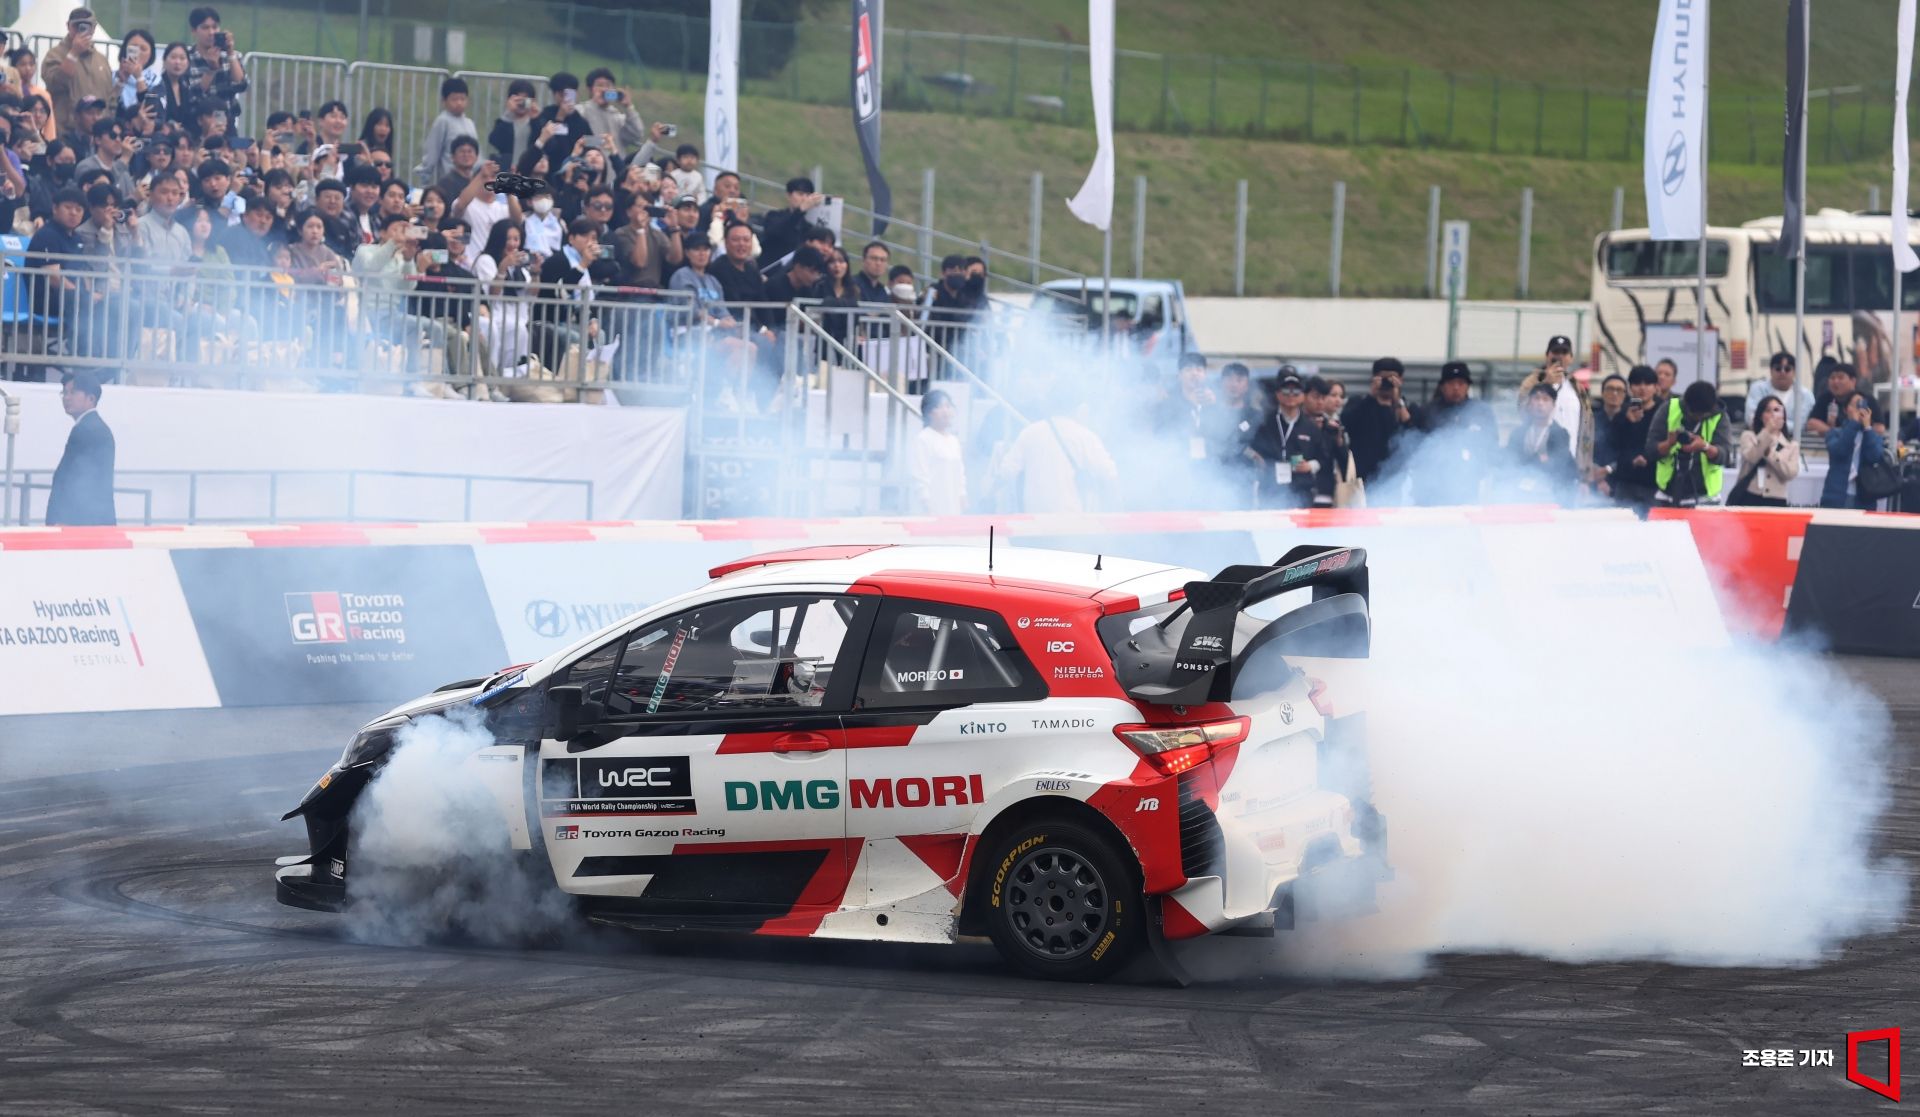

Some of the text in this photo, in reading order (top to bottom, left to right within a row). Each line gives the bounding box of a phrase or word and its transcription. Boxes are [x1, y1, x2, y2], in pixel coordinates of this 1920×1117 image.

[341, 593, 404, 607] TOYOTA
[33, 598, 111, 621] Hyundai N
[346, 609, 403, 624] GAZOO
[292, 612, 345, 641] GR
[16, 626, 68, 645] GAZOO
[69, 624, 121, 647] Racing
[349, 625, 406, 644] Racing
[73, 655, 128, 666] FESTIVAL
[306, 653, 338, 664] Pushing
[897, 670, 947, 683] MORIZO
[1054, 666, 1104, 674] NISULA
[646, 675, 668, 714] DMG
[1032, 719, 1095, 729] TAMADIC
[599, 767, 671, 787] WRC
[724, 774, 985, 811] DMG MORI
[1035, 780, 1071, 791] ENDLESS
[570, 803, 581, 811] FIA
[582, 803, 600, 811] World
[601, 803, 616, 812] Rally
[617, 801, 658, 812] Championship
[583, 829, 632, 838] TOYOTA
[635, 828, 680, 838] GAZOO
[682, 826, 726, 837] Racing
[330, 860, 345, 876] OMP
[991, 835, 1046, 908] SCORPION
